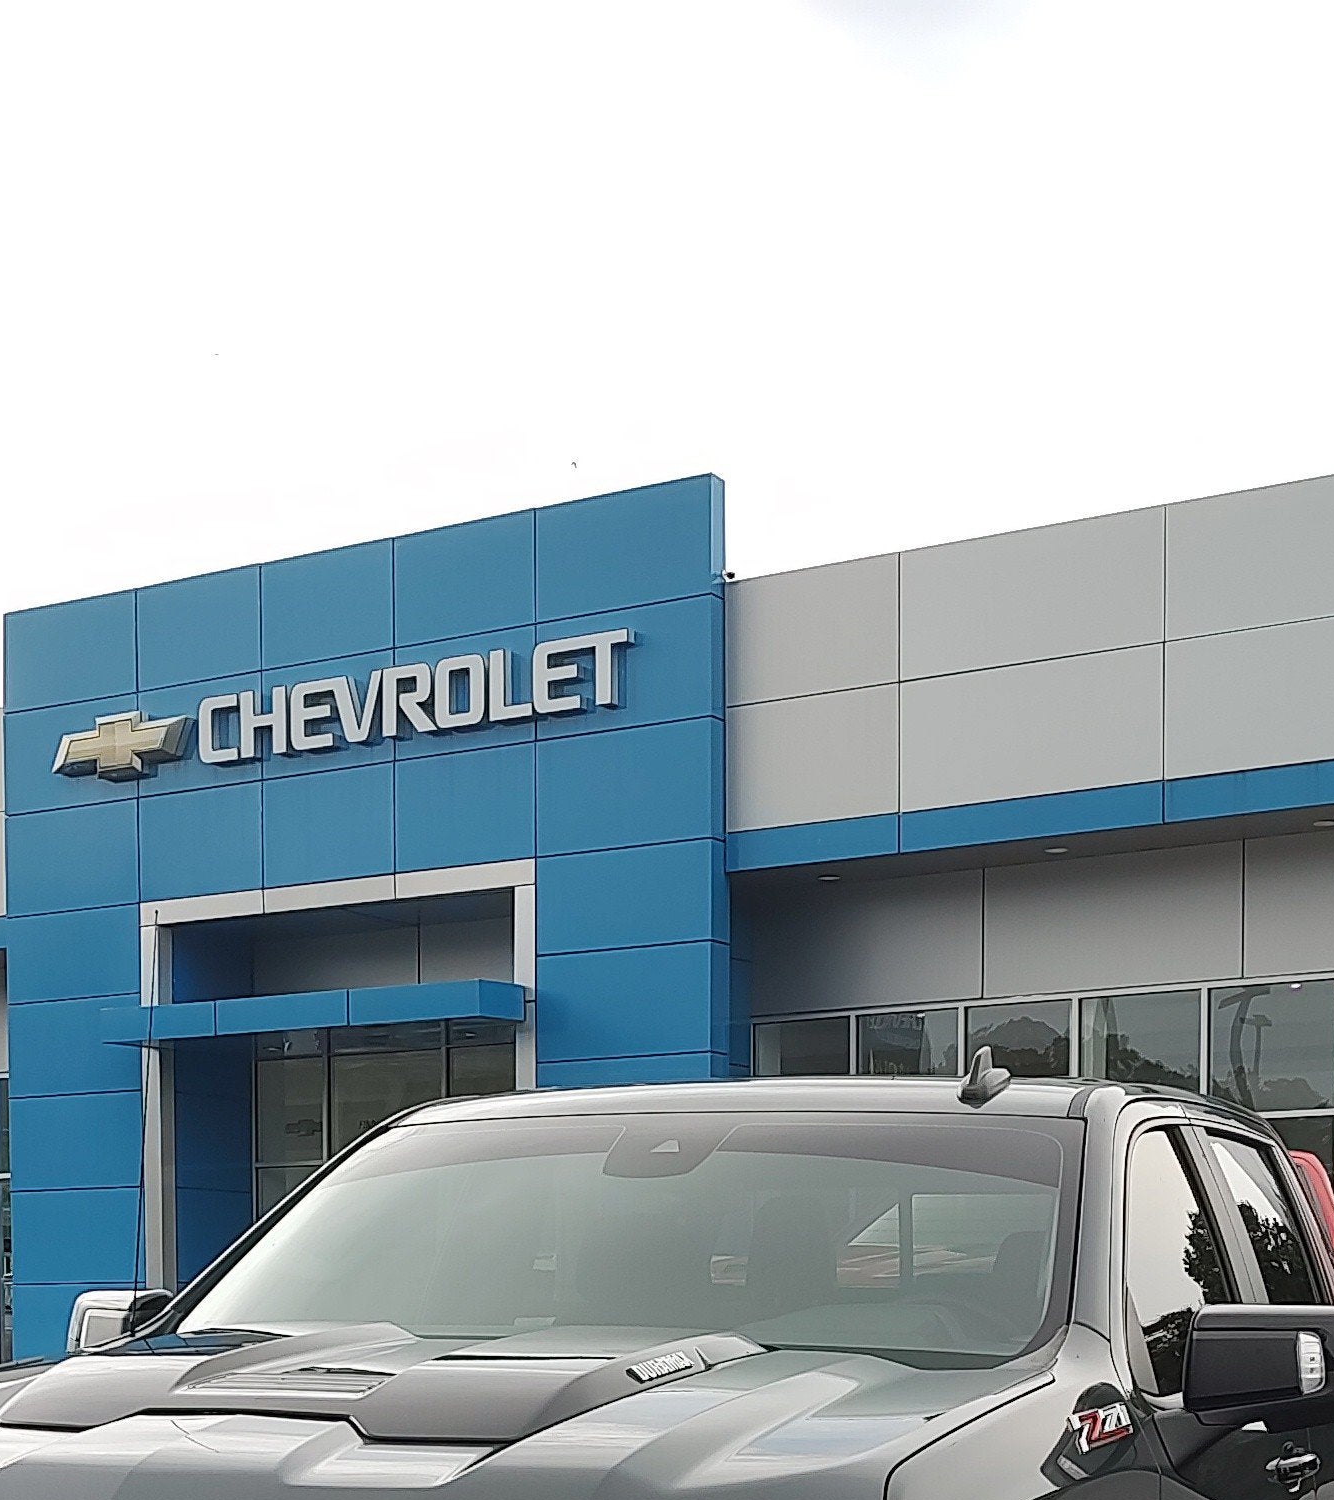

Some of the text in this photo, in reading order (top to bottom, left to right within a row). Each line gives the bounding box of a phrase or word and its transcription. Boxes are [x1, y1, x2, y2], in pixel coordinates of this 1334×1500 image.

[198, 627, 635, 764] CHEVROLET
[630, 1351, 695, 1381] DURAMAX
[1066, 1401, 1134, 1455] Z71
